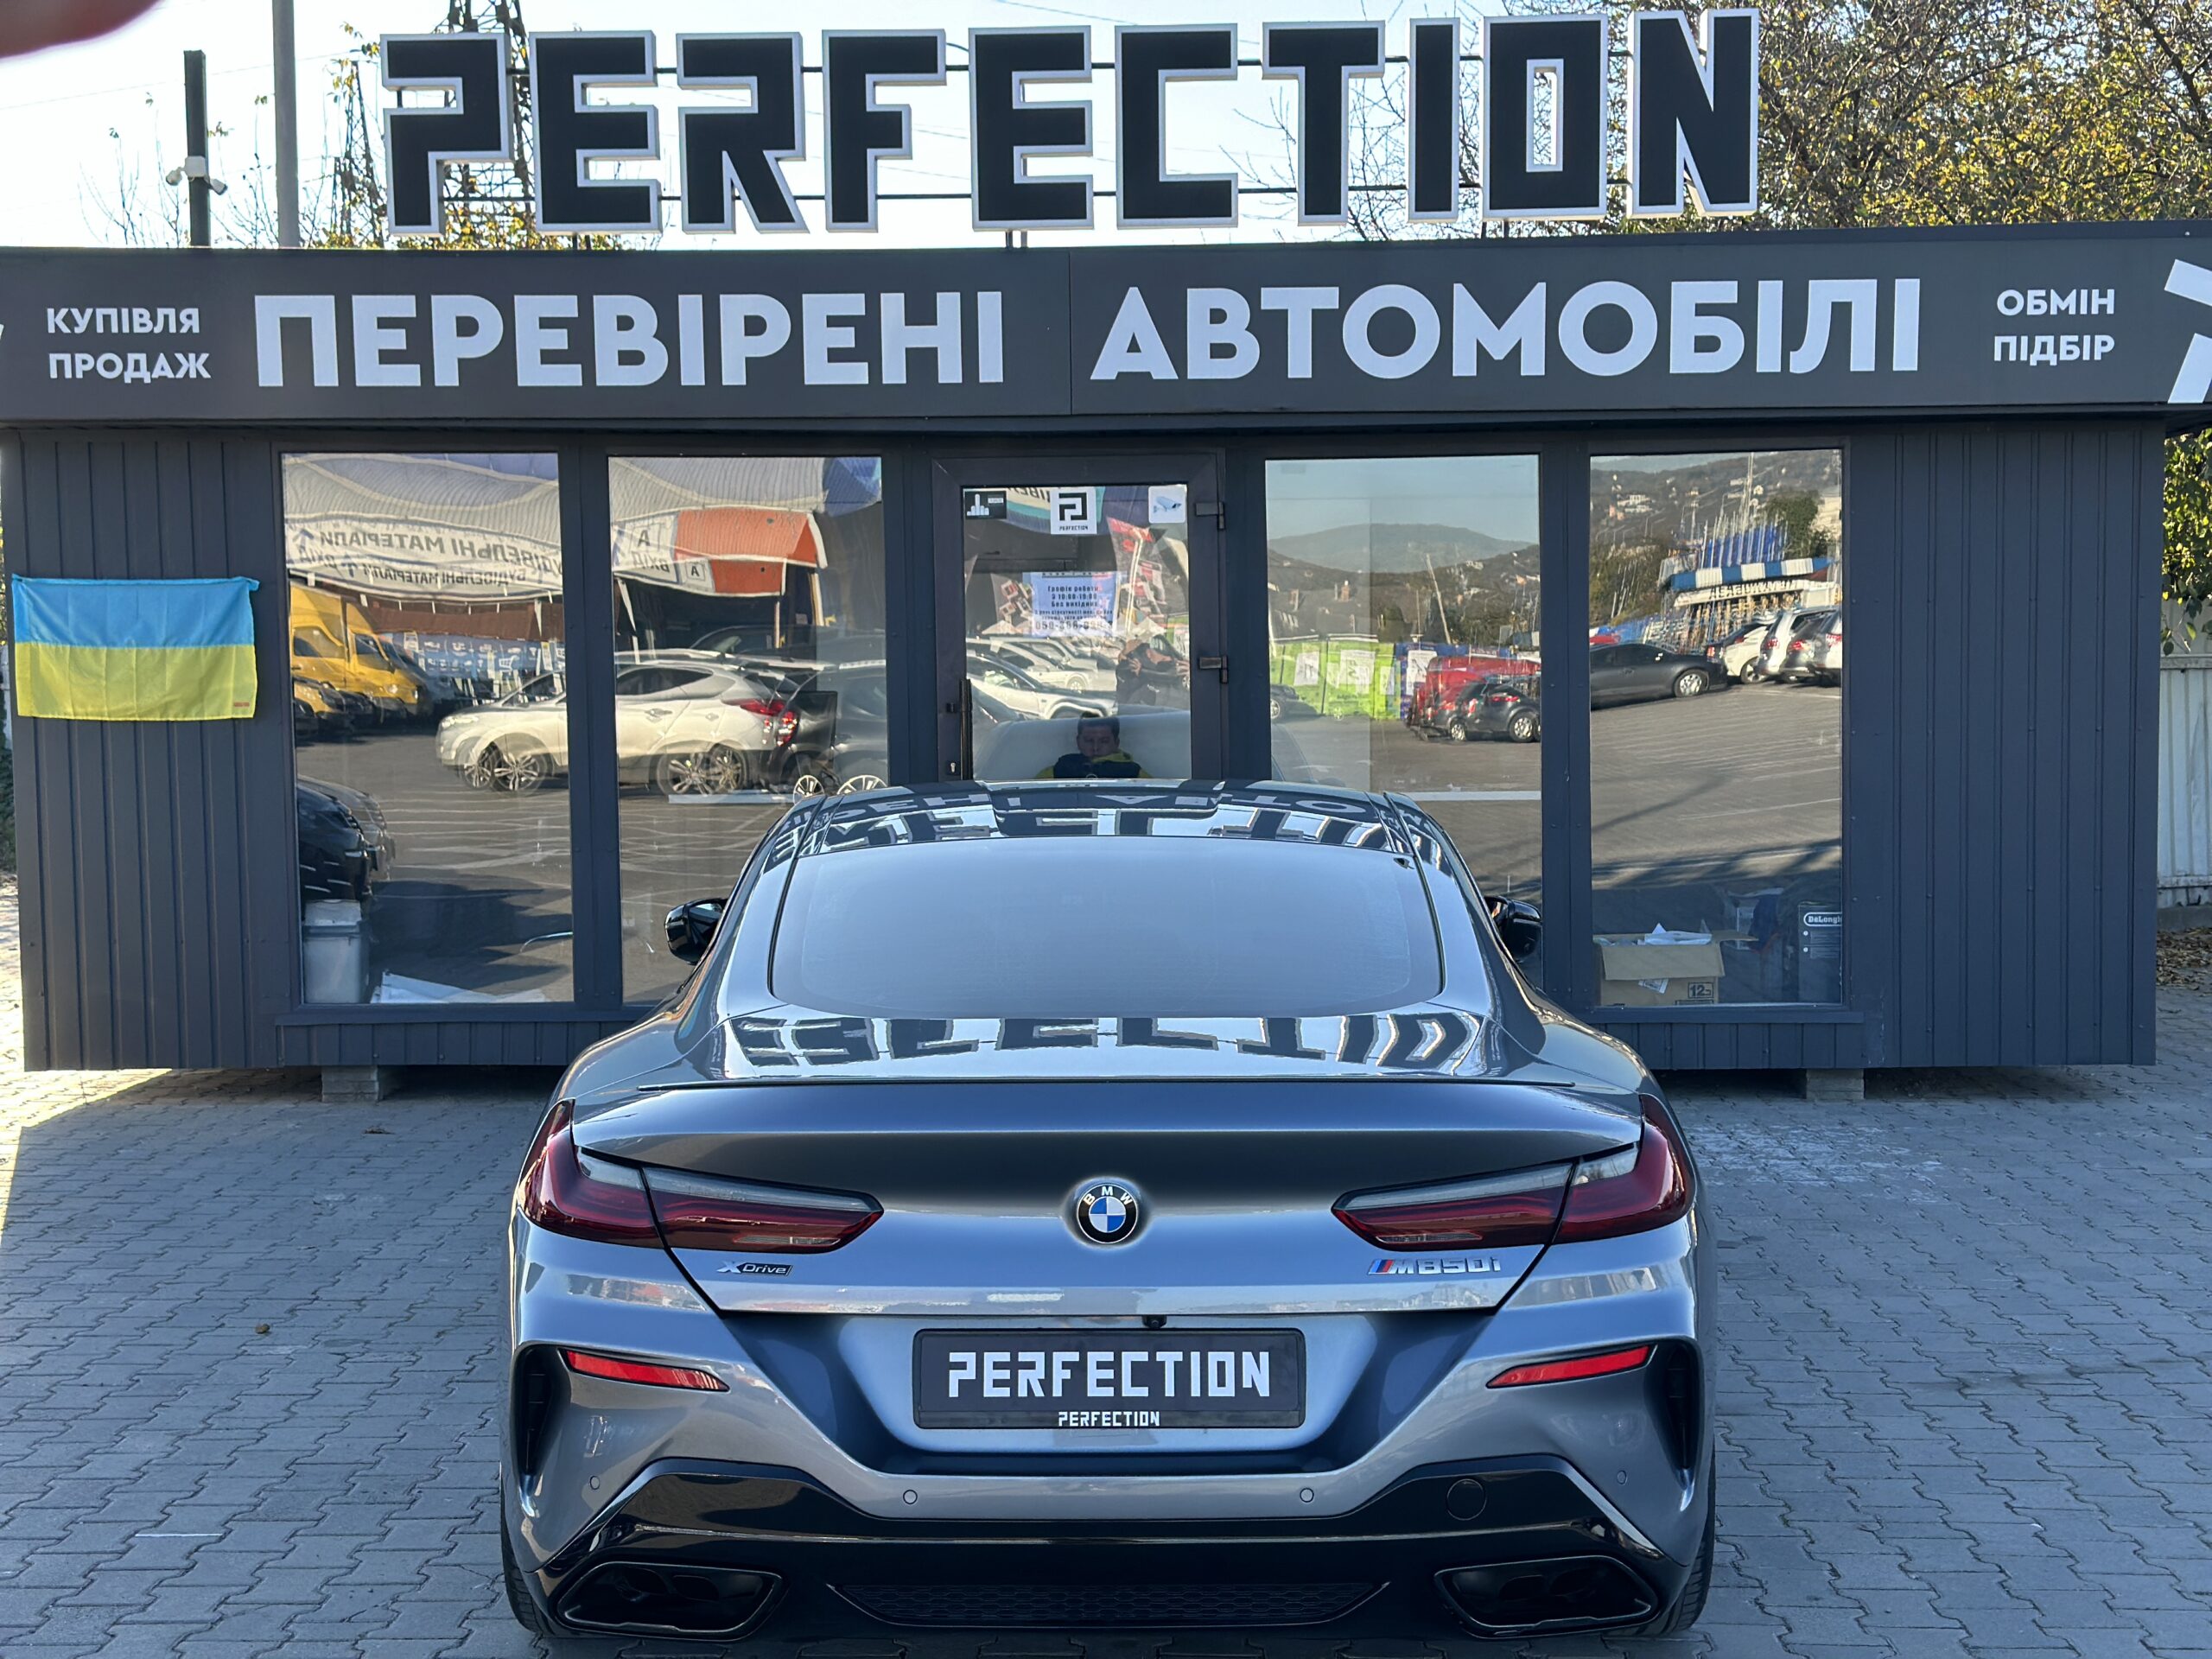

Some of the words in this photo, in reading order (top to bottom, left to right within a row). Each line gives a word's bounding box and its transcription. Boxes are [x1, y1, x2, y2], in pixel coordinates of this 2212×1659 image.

[380, 7, 1759, 236] PERFECTION
[1996, 289, 2115, 316] ОБМІН
[47, 308, 200, 334] КУПІВЛЯ
[254, 291, 1003, 387] ПЕРЕВІРЕНІ
[1090, 278, 1921, 380] АВТОМОБІЛІ
[1993, 334, 2115, 366] ПІДБІР
[48, 353, 212, 384] ПРОДАЖ
[1083, 1185, 1134, 1205] BMW
[1388, 1256, 1501, 1275] M850i
[949, 1351, 1270, 1397] PERFECTION
[1058, 1411, 1160, 1427] PERFECTION
